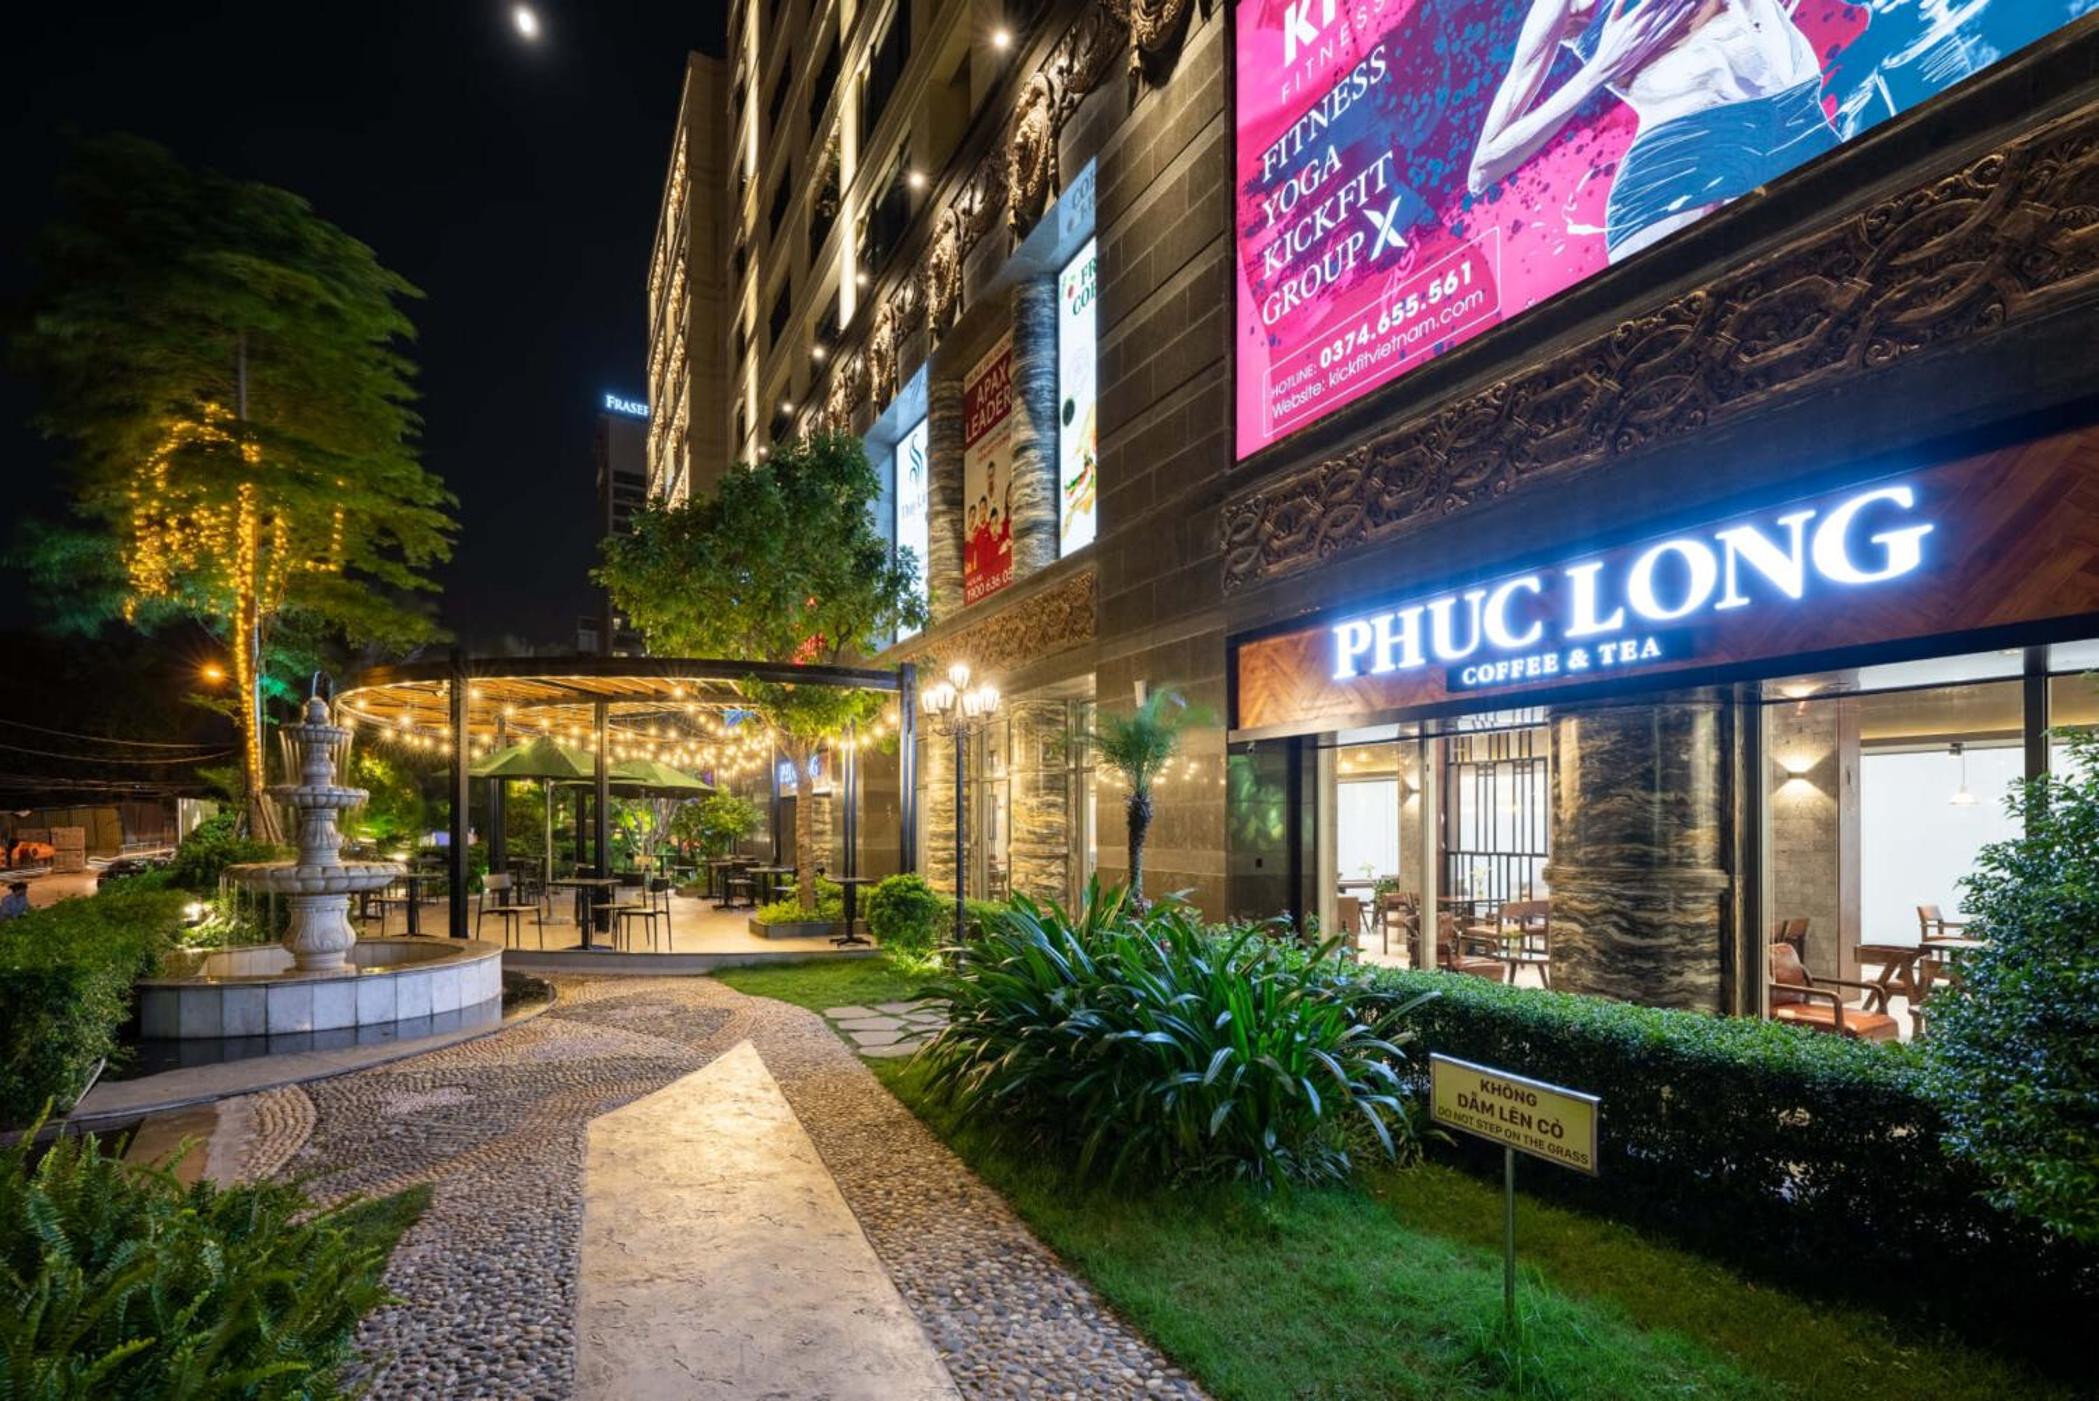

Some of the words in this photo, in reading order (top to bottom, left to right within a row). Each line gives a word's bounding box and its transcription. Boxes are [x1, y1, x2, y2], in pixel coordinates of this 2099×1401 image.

[1262, 45, 1387, 183] FITNESS
[1262, 144, 1343, 229] YOGA
[1262, 150, 1393, 279] KICKFIT
[1263, 231, 1365, 325] GROUP
[1363, 195, 1409, 261] X
[1271, 363, 1318, 397] HOTLINE:
[1320, 261, 1472, 368] 0374.655.561
[1272, 379, 1326, 418] Website:
[1329, 290, 1484, 388] kickfitvietnam.com
[966, 384, 1012, 443] LEADER
[976, 360, 1008, 410] APAX
[1332, 576, 1543, 682] PHUC
[1563, 486, 1935, 638] LONG
[1461, 651, 1559, 686] COFFEE
[1567, 648, 1589, 669] &
[1599, 636, 1663, 666] TEA
[1480, 1078, 1537, 1107] KHÔNG
[1499, 1105, 1532, 1130] LÊN
[1537, 1119, 1564, 1139] CỎ
[1438, 1106, 1450, 1118] DO
[1453, 1112, 1475, 1126] NOT
[1475, 1119, 1502, 1134] STEP
[1504, 1128, 1520, 1142] ON
[1523, 1135, 1545, 1149] THE
[1547, 1143, 1589, 1165] GRASS
